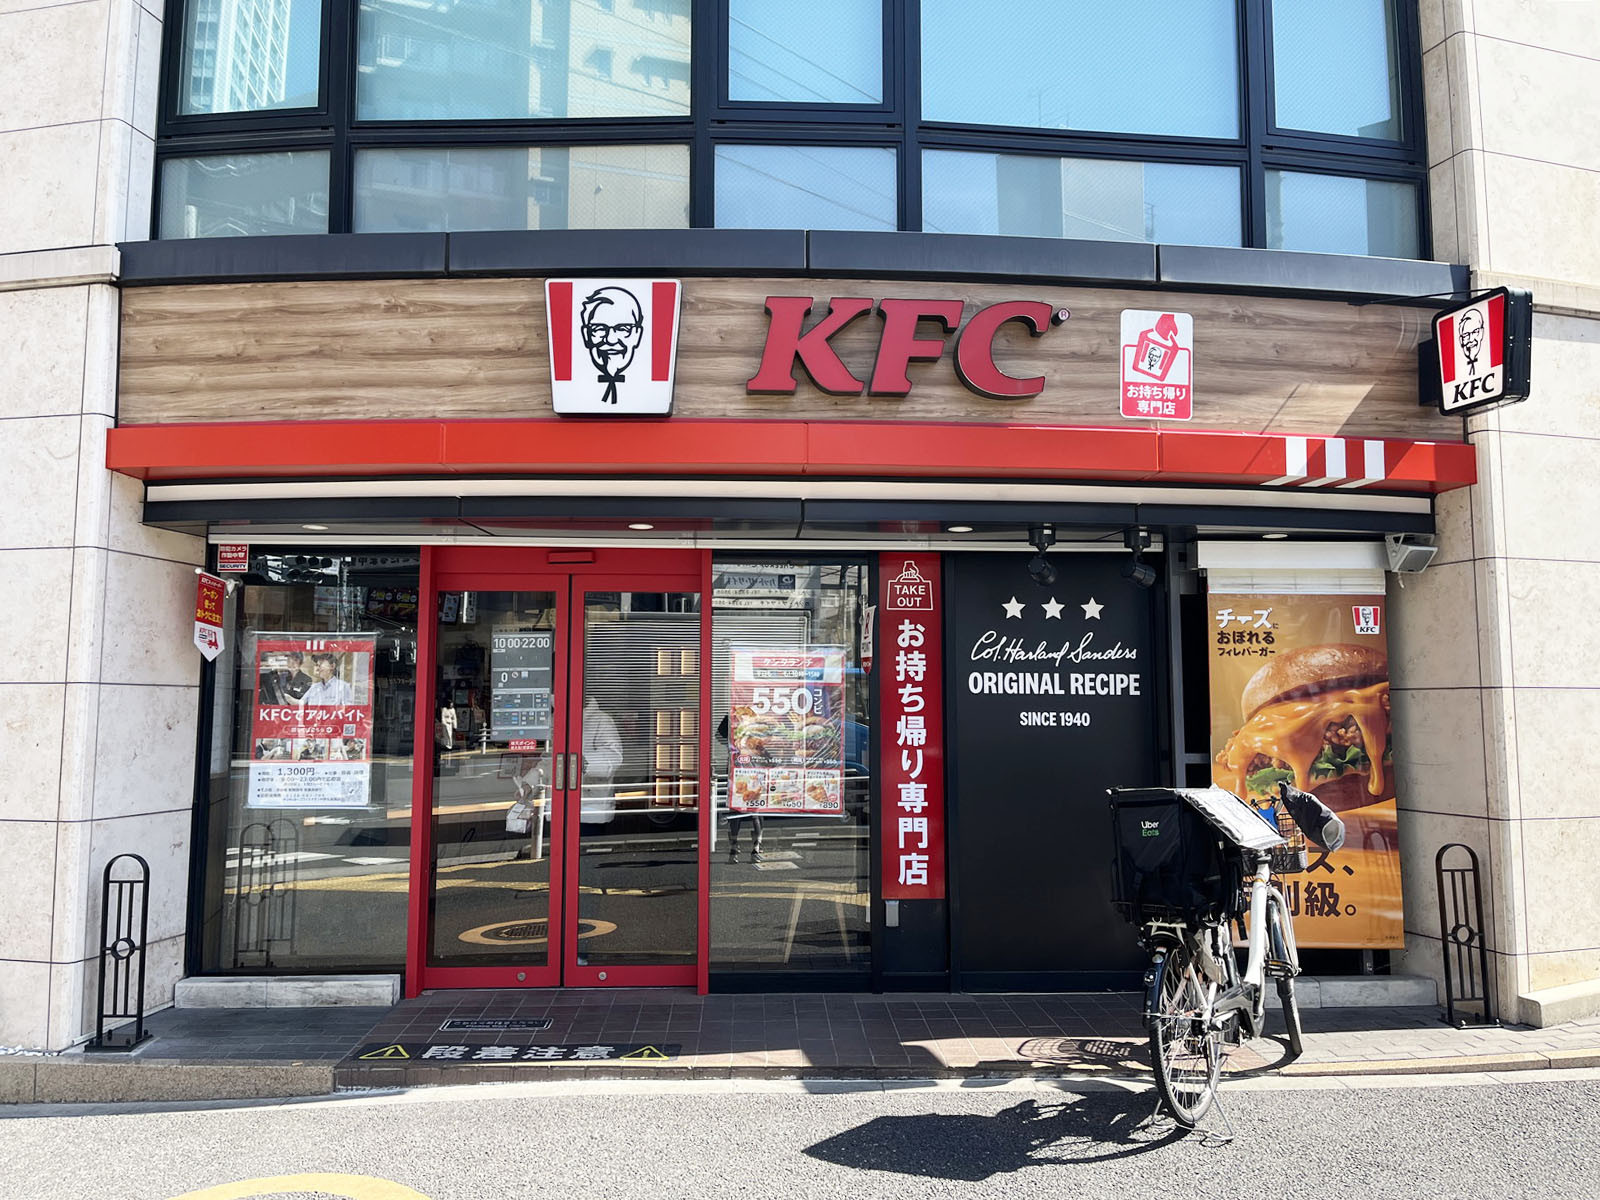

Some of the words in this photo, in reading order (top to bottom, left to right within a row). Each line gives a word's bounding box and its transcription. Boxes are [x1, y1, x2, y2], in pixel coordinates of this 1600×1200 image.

[747, 296, 1054, 400] KFC
[1127, 385, 1186, 400] お持ち帰り
[1452, 373, 1495, 404] KFC
[1137, 400, 1176, 415] 専門店
[894, 585, 926, 596] TAKE
[896, 597, 922, 608] OUT
[1216, 629, 1275, 645] おぼれる
[970, 630, 1007, 662] Col.
[1003, 638, 1070, 667] Harland
[1066, 631, 1137, 664] Sanders
[1216, 646, 1276, 657] フィレバーガー
[968, 671, 1065, 695] ORIGINAL
[1070, 673, 1141, 696] RECIPE
[751, 687, 814, 715] 550
[259, 708, 365, 721] KFCでアルバイト
[1019, 711, 1057, 726] SINCE
[1059, 712, 1091, 727] 1940
[895, 619, 929, 886] お持ち帰り専門店
[1141, 820, 1160, 829] Uber
[1142, 829, 1160, 837] Eats
[421, 1045, 616, 1060] 段差注意
